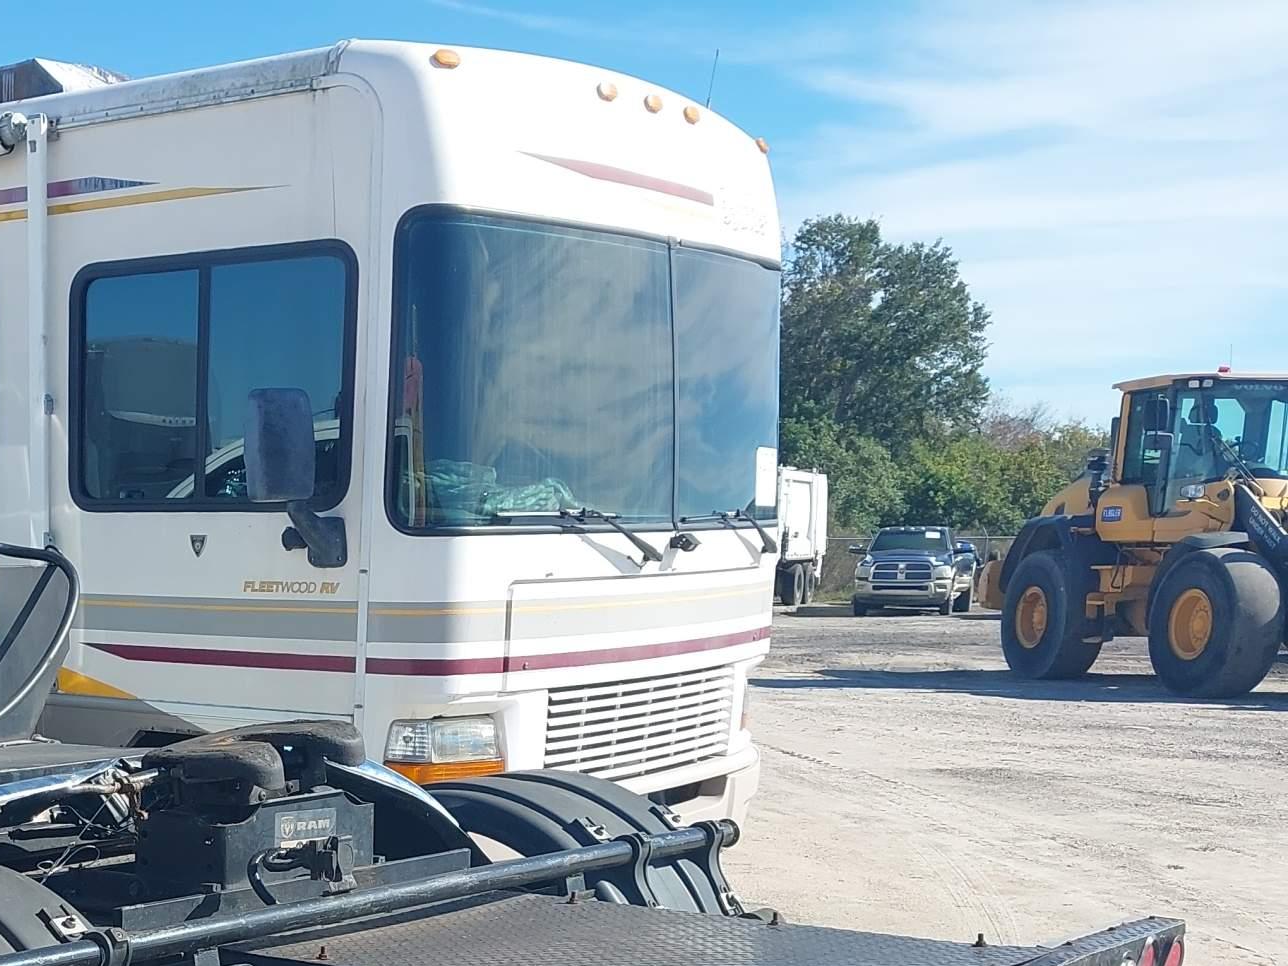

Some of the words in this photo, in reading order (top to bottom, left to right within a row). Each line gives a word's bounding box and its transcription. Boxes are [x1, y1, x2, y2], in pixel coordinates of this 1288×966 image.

[243, 580, 317, 594] FLEETWOOD
[319, 581, 341, 595] RV
[296, 818, 331, 831] RAM
